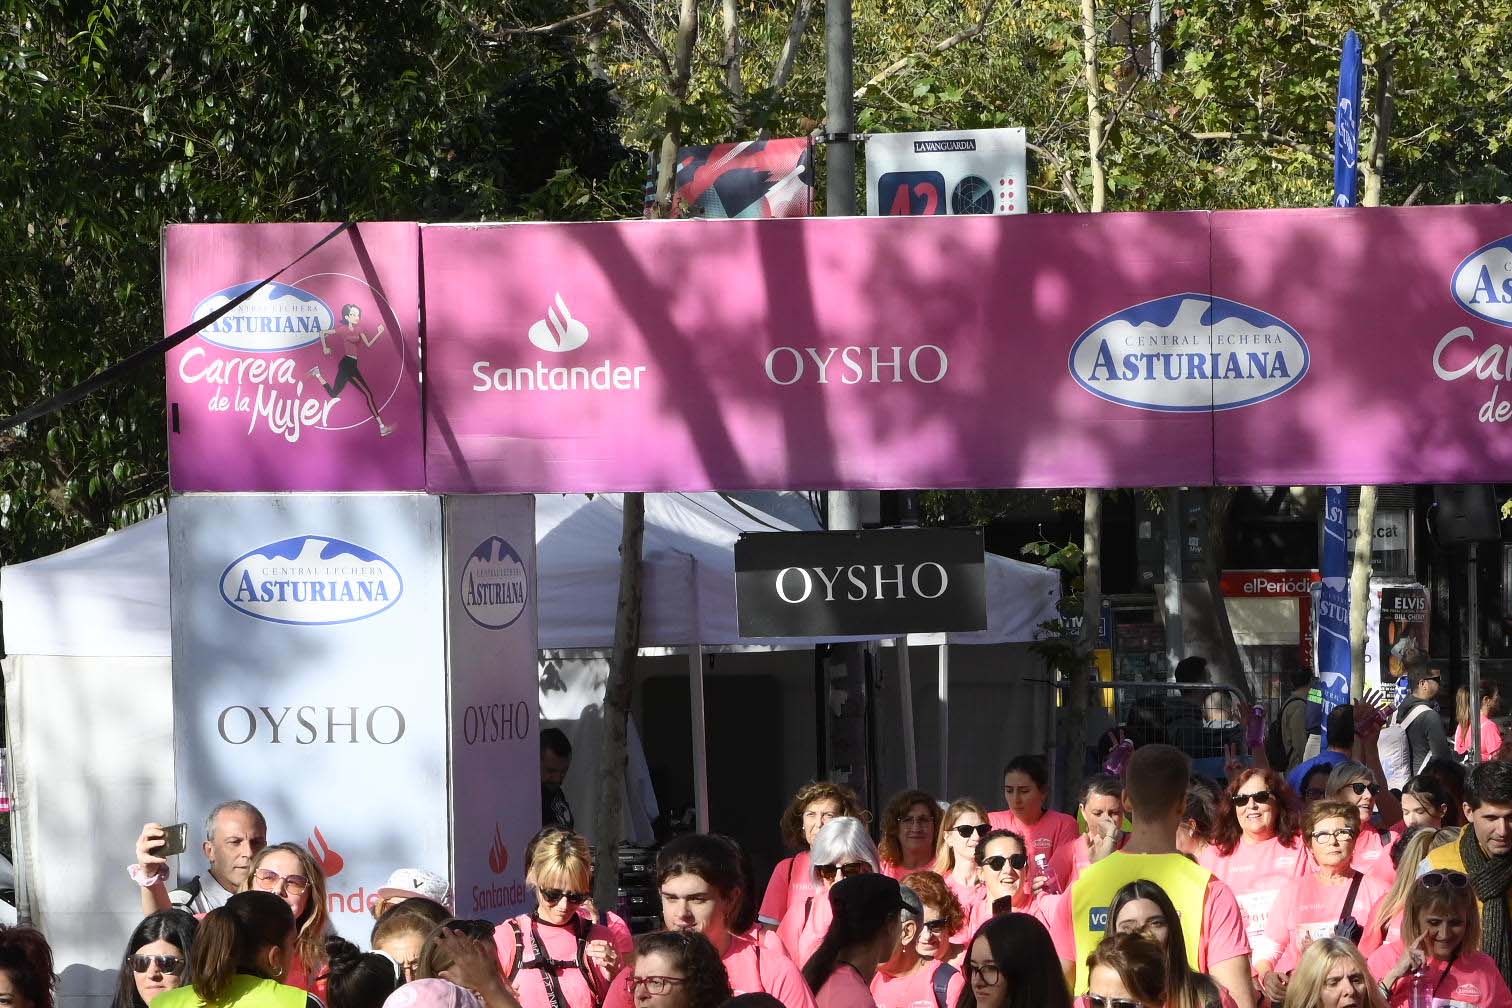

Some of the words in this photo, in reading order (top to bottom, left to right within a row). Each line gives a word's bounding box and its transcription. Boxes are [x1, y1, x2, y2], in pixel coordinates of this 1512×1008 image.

[1088, 338, 1291, 381] ASTURIANA
[1125, 335, 1199, 346] CENTRAL
[178, 347, 297, 384] Carrera
[472, 360, 648, 392] Santander
[764, 343, 950, 386] OYSHO
[209, 387, 230, 412] de
[234, 386, 250, 412] la
[247, 381, 341, 442] Mujer
[1478, 383, 1512, 424] de
[234, 569, 389, 603] ASTURIANA
[466, 571, 524, 607] ASTURIANA
[775, 562, 949, 603] OYSHO
[1394, 597, 1425, 609] ELVIS
[217, 705, 406, 745] OYSHO
[463, 701, 530, 745] OYSHO
